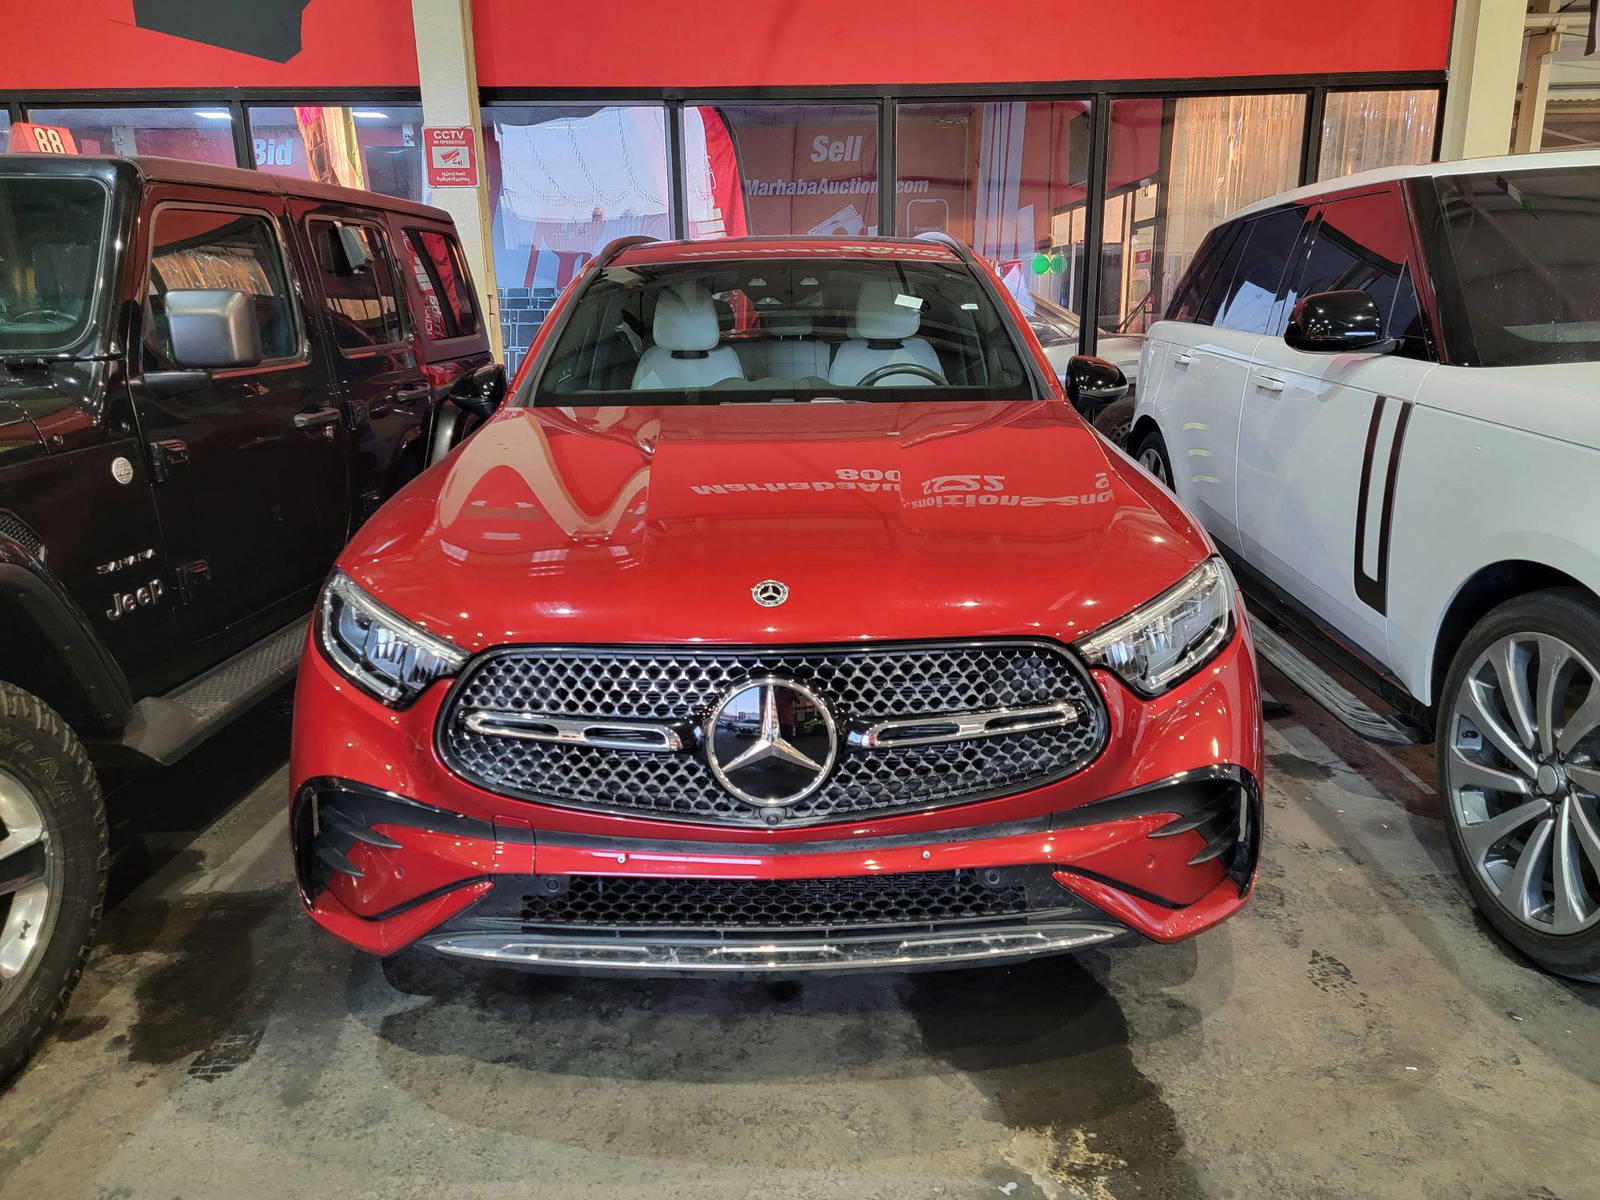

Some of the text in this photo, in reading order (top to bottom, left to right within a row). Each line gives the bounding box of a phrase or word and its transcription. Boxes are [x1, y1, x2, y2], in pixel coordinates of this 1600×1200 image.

[33, 127, 66, 154] 88
[433, 130, 464, 140] CCTV
[811, 135, 863, 162] Sell
[254, 138, 293, 165] Bid
[106, 578, 165, 621] Jeep
